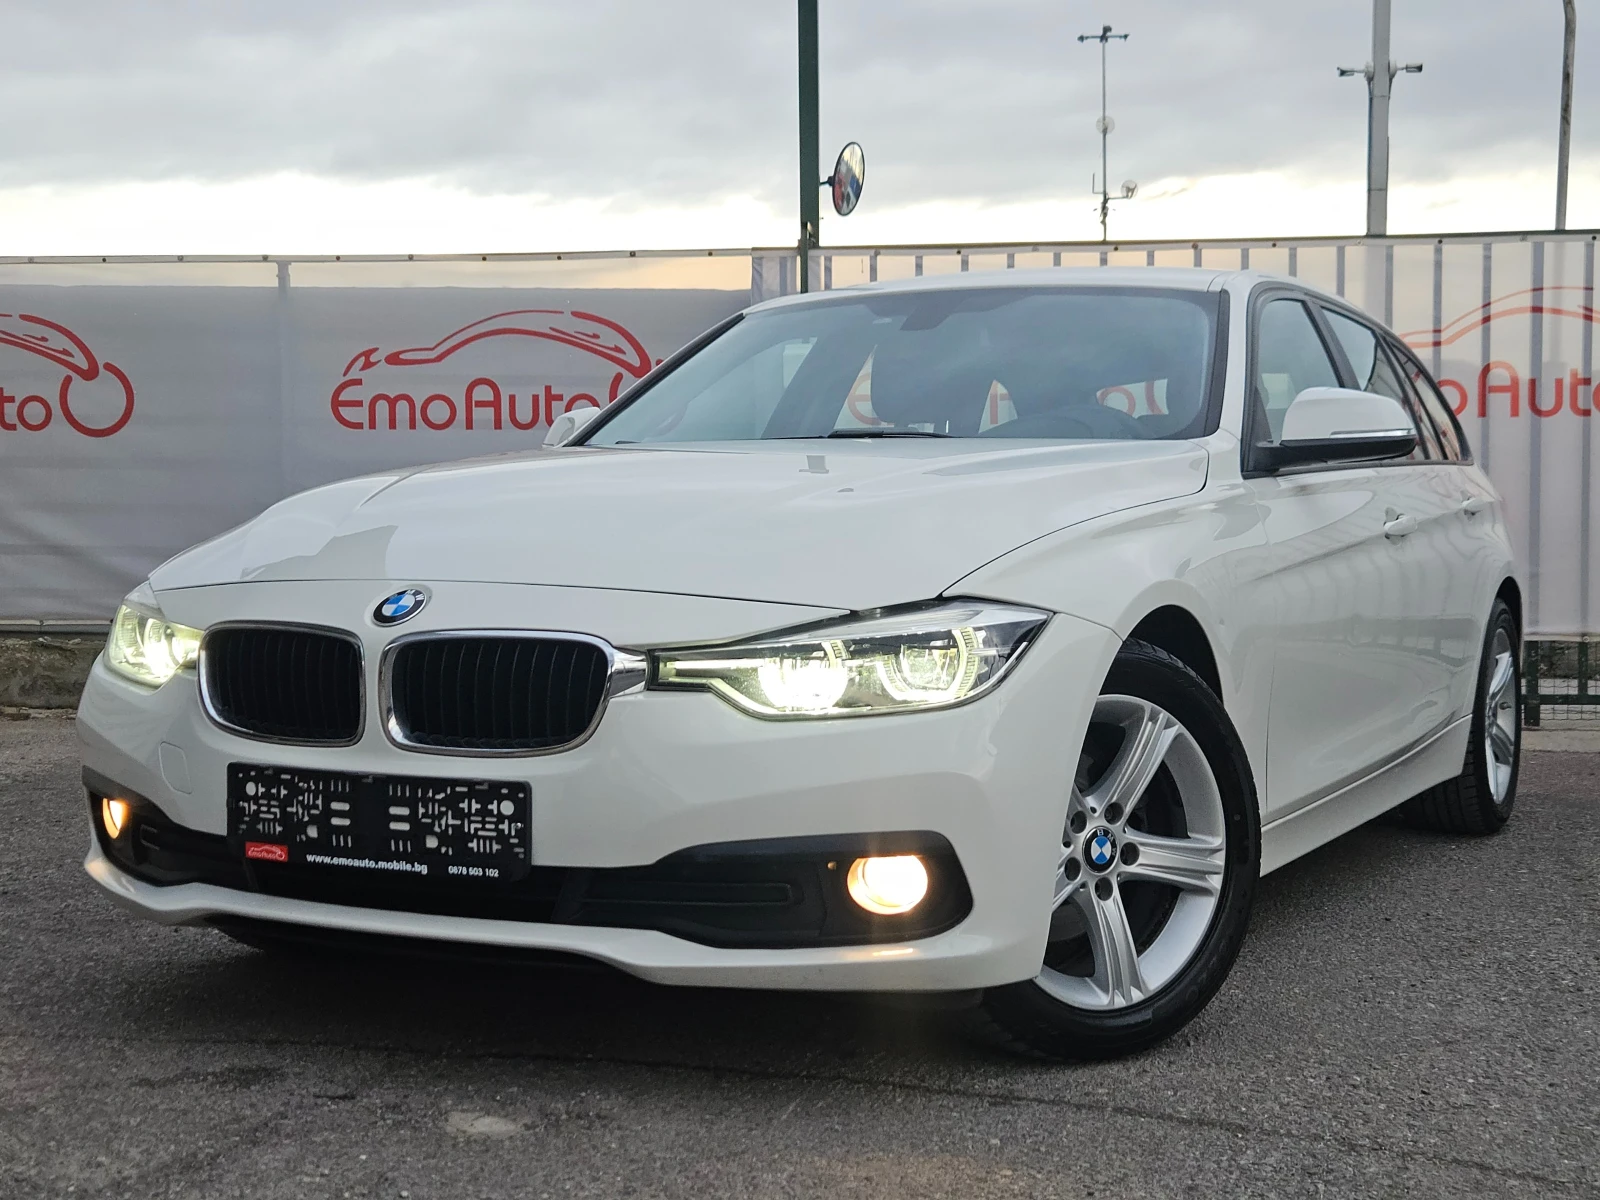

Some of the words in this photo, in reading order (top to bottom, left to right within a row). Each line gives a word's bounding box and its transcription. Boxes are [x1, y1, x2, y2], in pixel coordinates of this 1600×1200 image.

[1437, 361, 1600, 418] oAut
[306, 853, 428, 875] www.emoauto.mobile.bg
[485, 868, 499, 877] 102
